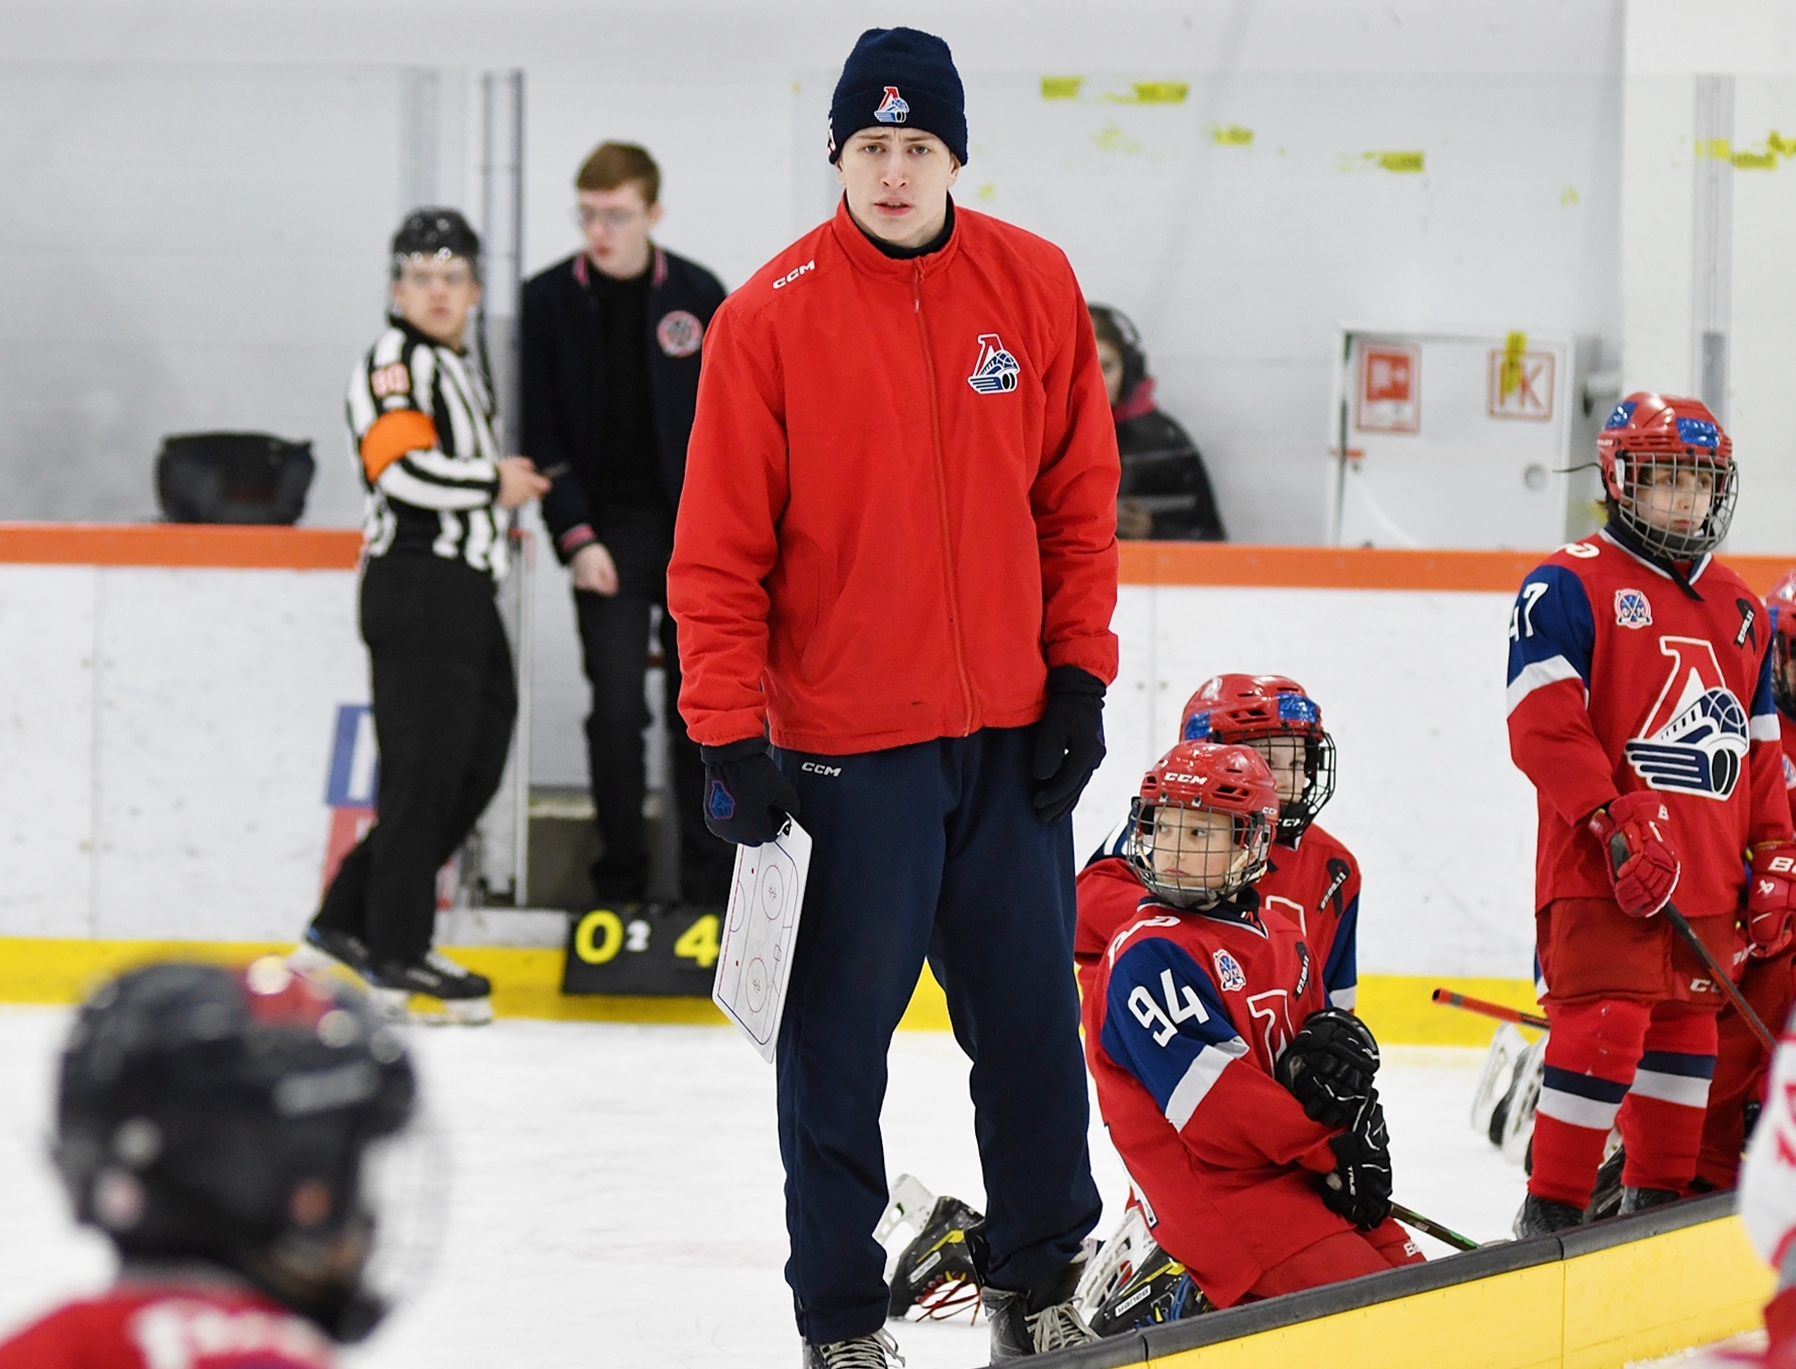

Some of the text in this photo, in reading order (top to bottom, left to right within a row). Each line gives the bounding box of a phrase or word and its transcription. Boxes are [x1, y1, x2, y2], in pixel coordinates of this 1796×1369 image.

[773, 259, 815, 289] CCM
[801, 761, 842, 777] CCM
[1164, 772, 1208, 785] CCM
[575, 909, 623, 964] 0
[674, 914, 720, 968] 4
[1128, 967, 1210, 1048] 94
